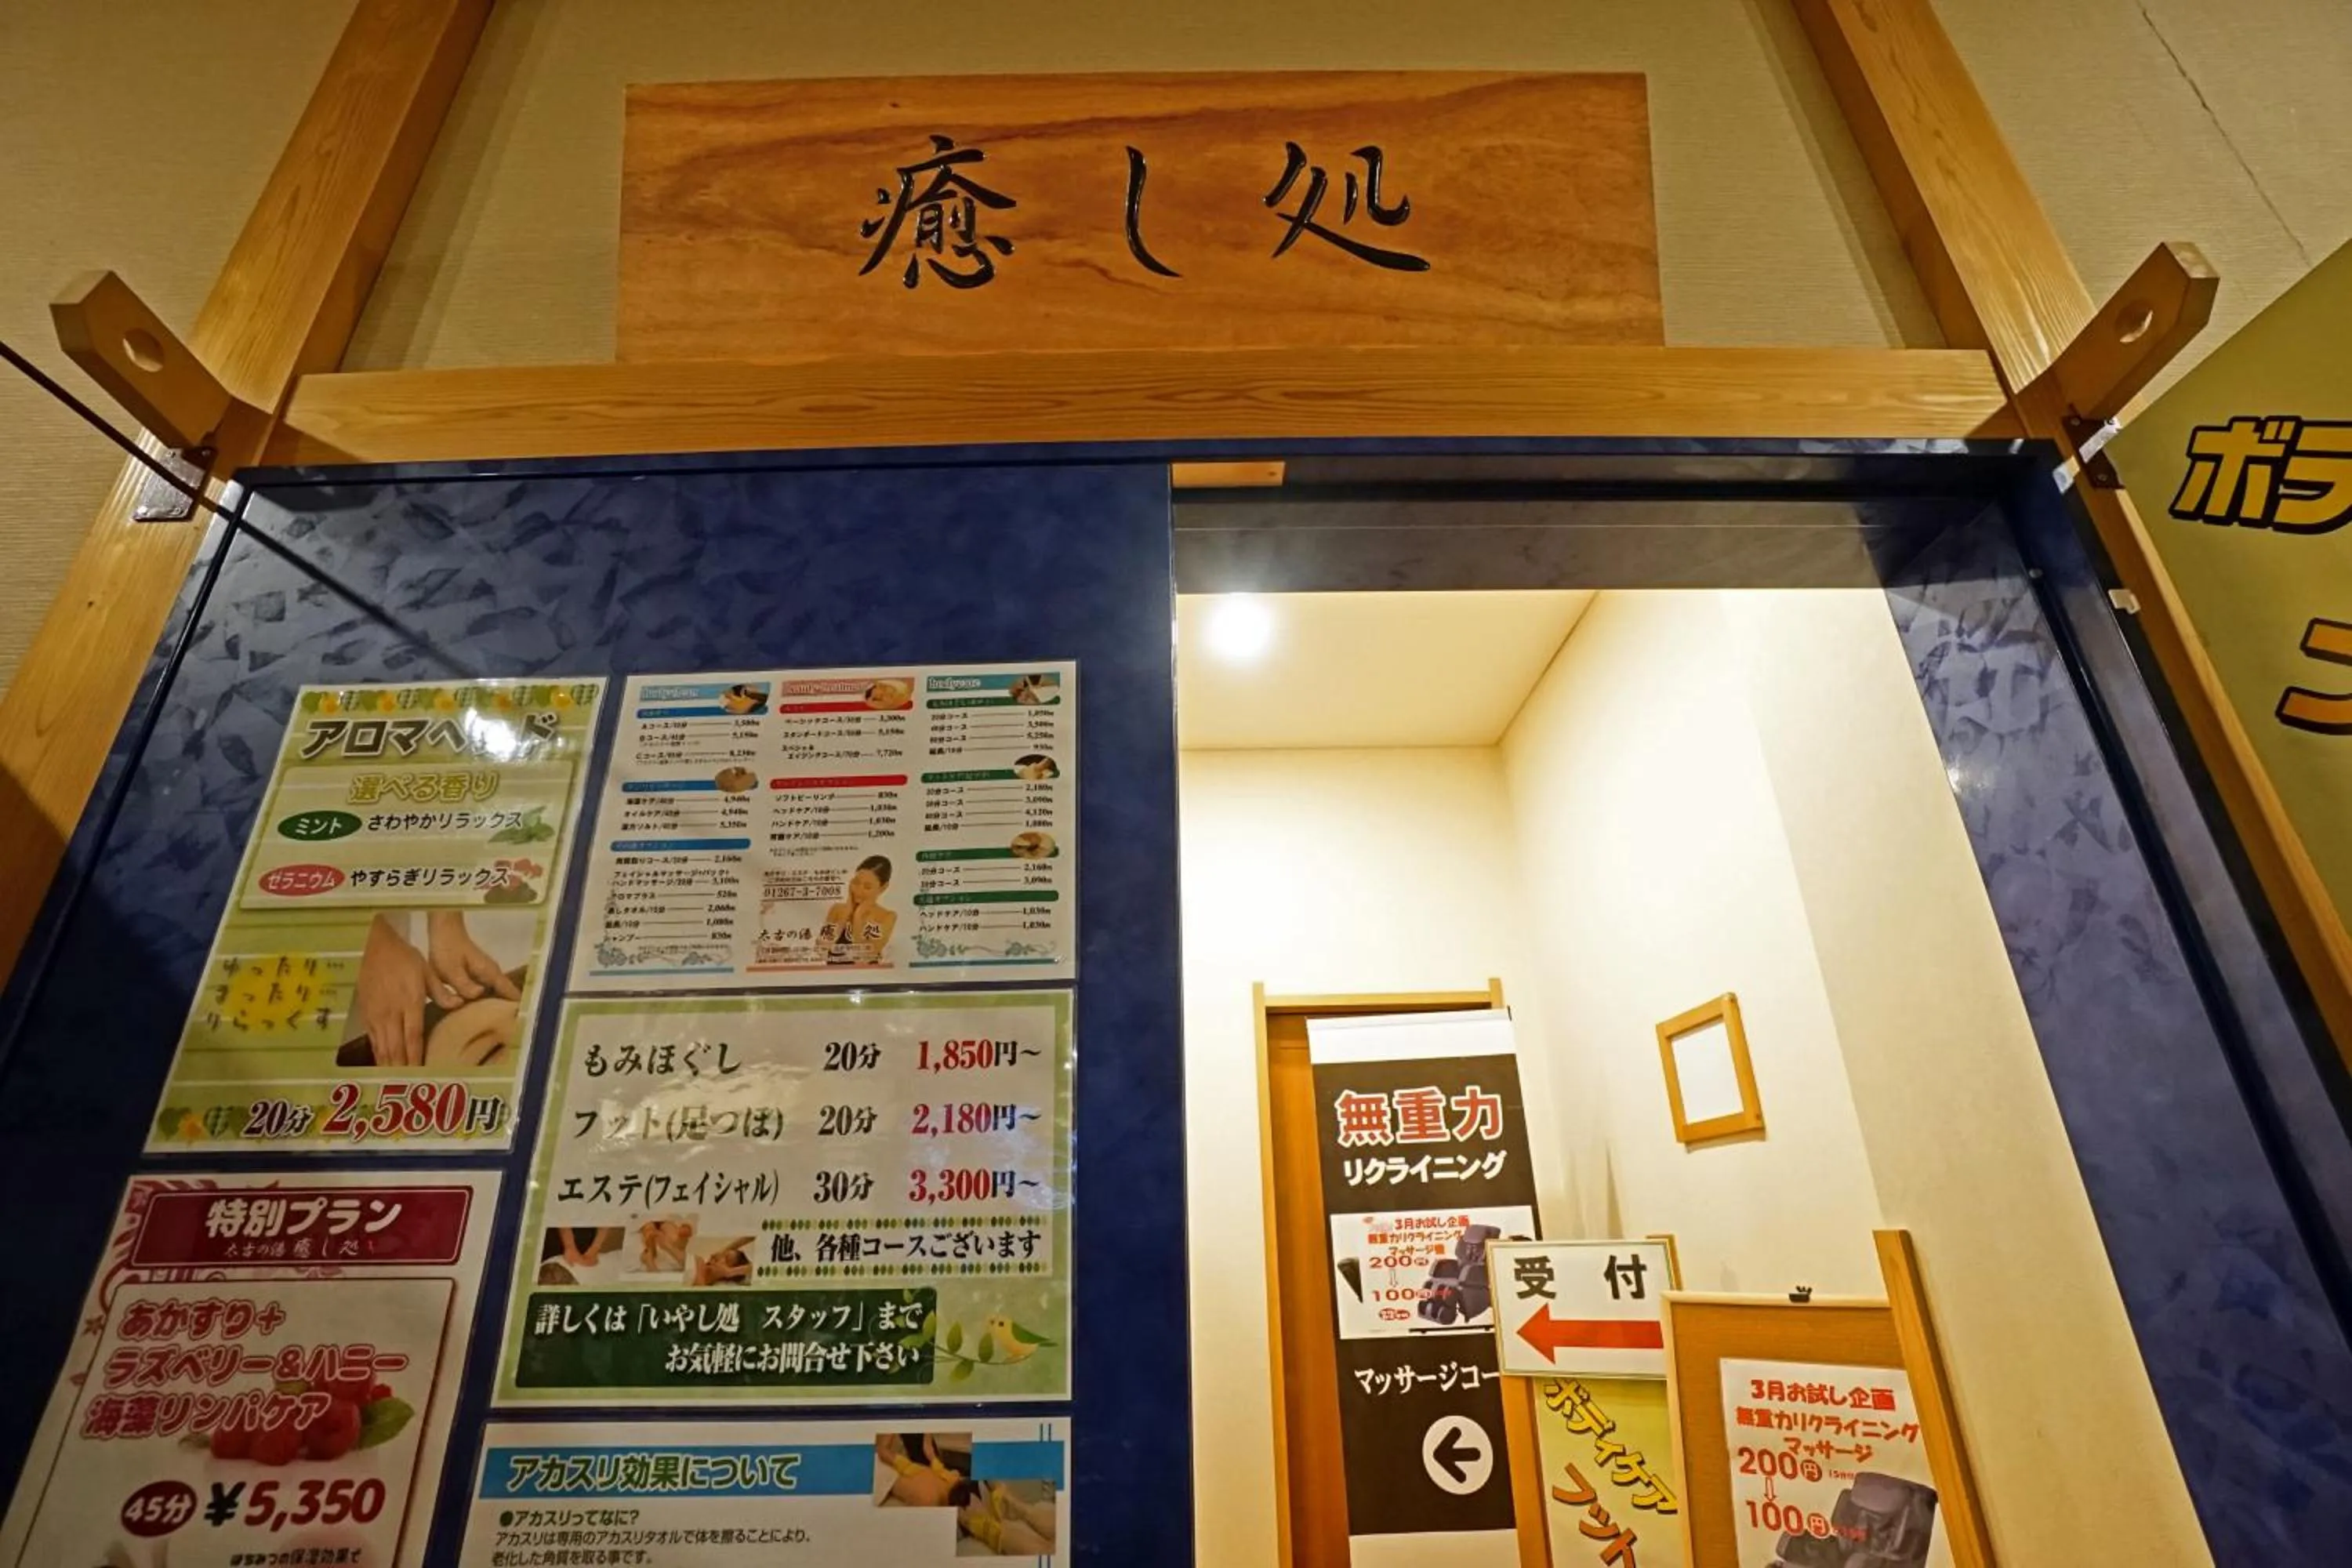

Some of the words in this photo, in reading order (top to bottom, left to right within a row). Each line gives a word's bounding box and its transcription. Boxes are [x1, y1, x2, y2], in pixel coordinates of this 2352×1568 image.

[300, 713, 557, 758] アロマヘド
[347, 771, 500, 804] 選べる香り
[295, 817, 343, 836] ミント
[368, 811, 522, 831] さわやかリラックス
[267, 869, 336, 890] ゼラニウム
[350, 867, 510, 887] やすらぎリラックス
[584, 1042, 742, 1076] もみほぐし
[824, 1044, 881, 1072] 20分
[243, 1101, 314, 1138] 20分
[321, 1080, 506, 1142] 2,580円
[818, 1105, 877, 1135] 20分
[1334, 1085, 1504, 1148] 無重力
[1344, 1149, 1508, 1186] リクライニング
[557, 1171, 779, 1207] エステ(フェイシャル)
[813, 1171, 875, 1203] 30分
[205, 1198, 402, 1239] 特別プラン
[771, 1229, 1041, 1263] 他、各種コースございます
[665, 1341, 920, 1376] お気軽にお問合せ下さい
[1750, 1379, 1896, 1412] 3月お試し企画
[1784, 1437, 1874, 1463] マッサージ
[506, 1451, 801, 1493] アカスリ効果について
[124, 1494, 190, 1523] 45分
[205, 1478, 387, 1531] ¥5,350
